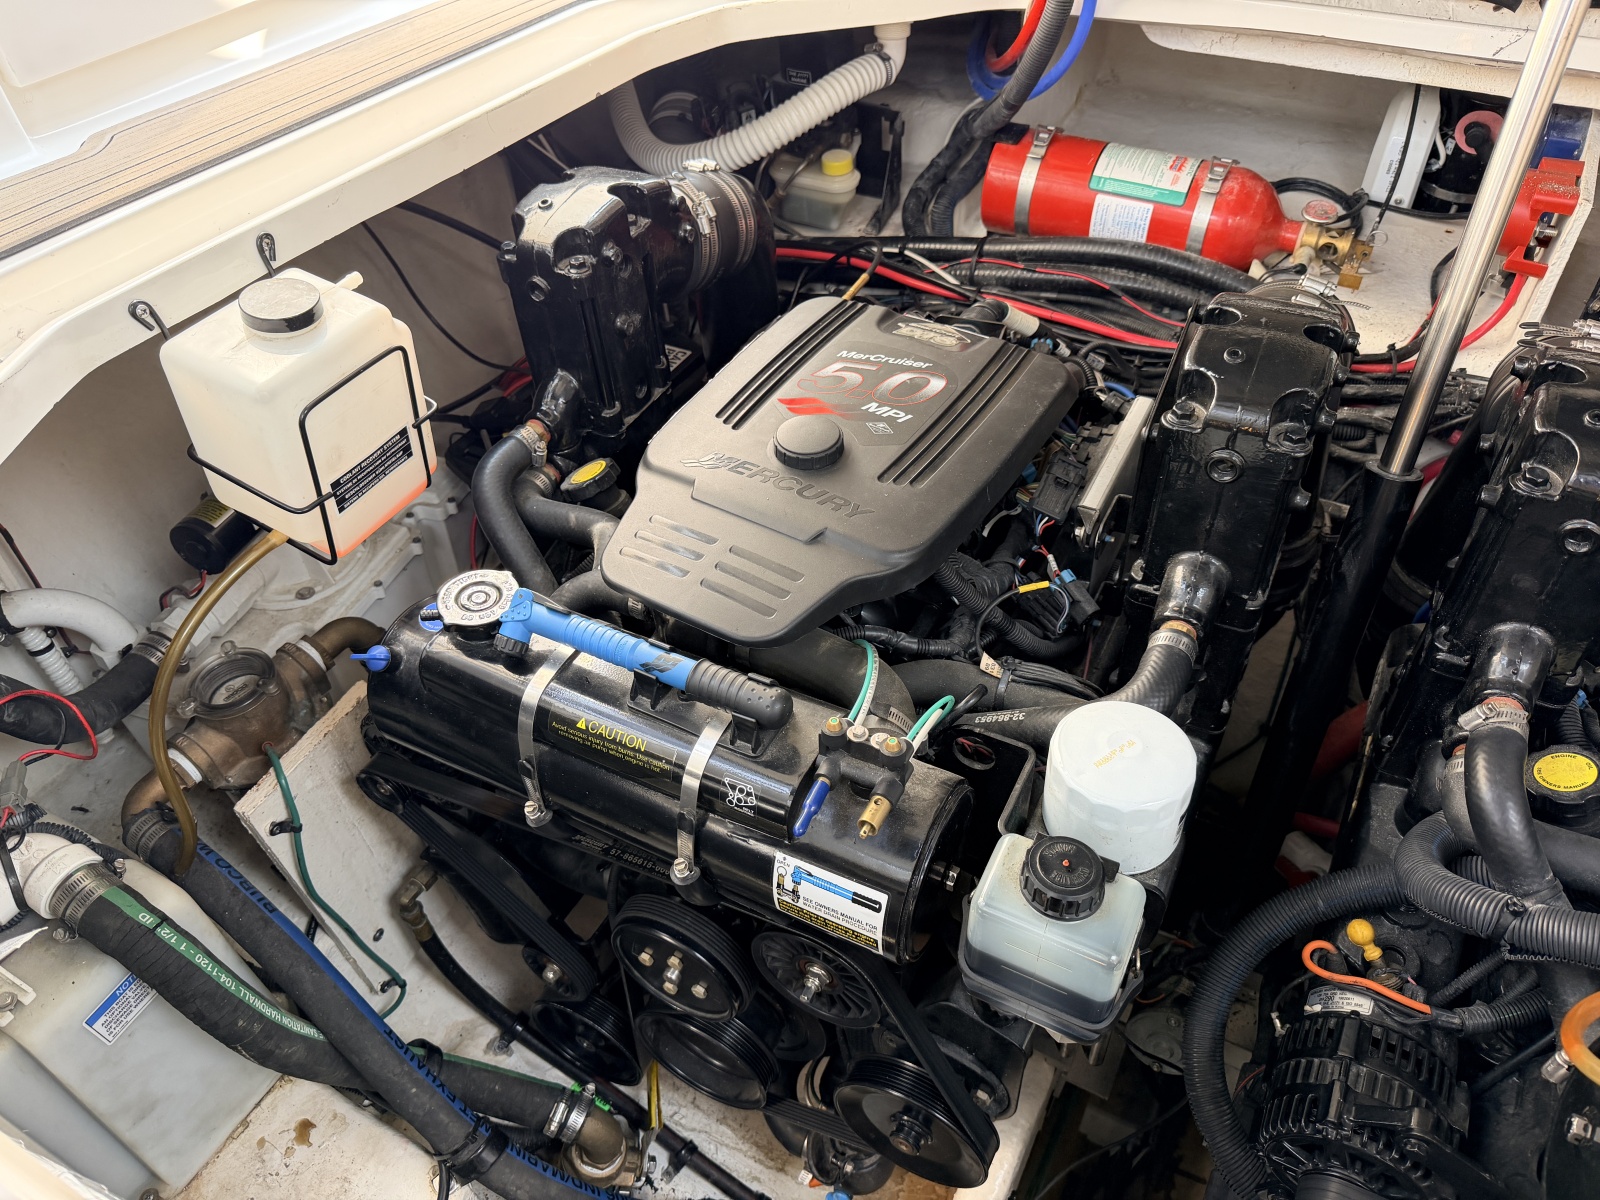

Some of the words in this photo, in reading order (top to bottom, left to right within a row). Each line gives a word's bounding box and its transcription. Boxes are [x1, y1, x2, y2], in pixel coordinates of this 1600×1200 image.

[837, 350, 933, 369] MerCruiser
[797, 360, 948, 406] 5.0
[861, 402, 914, 423] MPI
[339, 465, 360, 484] COOLANT
[361, 447, 383, 468] RECOVERY
[383, 433, 400, 450] SYSTEM
[680, 452, 876, 518] MERCURY
[975, 713, 1025, 723] 32-864953
[551, 720, 567, 731] Avoid
[568, 727, 587, 739] serious
[588, 735, 603, 746] injury
[604, 741, 617, 750] from
[648, 758, 670, 770] caution
[588, 721, 646, 752] CAUTION
[592, 743, 607, 753] pump
[1539, 776, 1562, 788] OWNERS
[803, 896, 812, 904] SEE
[814, 900, 839, 915] OWNERS
[840, 911, 863, 925] MANUAL
[866, 922, 877, 930] FOR
[803, 900, 822, 912] WATER
[824, 909, 840, 920] DRAIN
[842, 917, 877, 936] PROCEDURE
[195, 954, 236, 990] 104-1120
[100, 1018, 108, 1026] AN
[107, 994, 132, 1018] OPTIONAL
[103, 1006, 115, 1017] THIS
[114, 992, 128, 1005] BOAT
[104, 1000, 132, 1028] DISCHARGE
[105, 1024, 113, 1032] OF
[112, 1003, 133, 1024] SEWAGE
[112, 1019, 123, 1030] FOR
[123, 1009, 133, 1019] USE
[133, 991, 150, 1008] WHERE
[239, 986, 282, 1022] HARDWALL
[283, 1017, 318, 1038] SANITATION
[384, 1027, 456, 1107] EXHAUST
